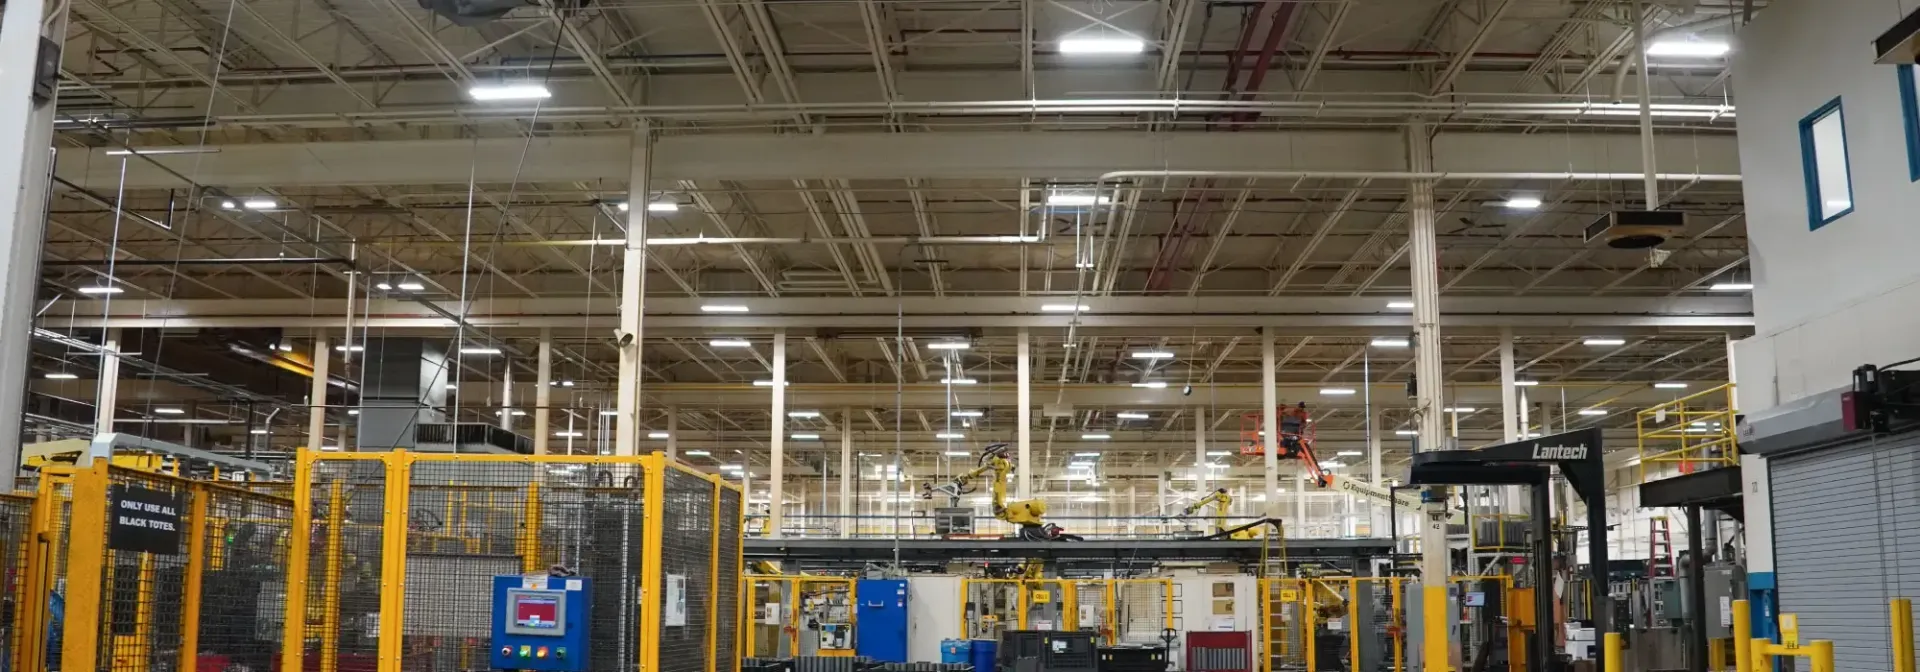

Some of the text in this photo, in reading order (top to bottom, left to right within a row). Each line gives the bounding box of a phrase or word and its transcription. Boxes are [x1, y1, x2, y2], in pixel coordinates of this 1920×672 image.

[1532, 443, 1588, 460] Lantech
[120, 500, 176, 516] ONLY USE ALL
[119, 516, 176, 531] BLACK TOTES.
